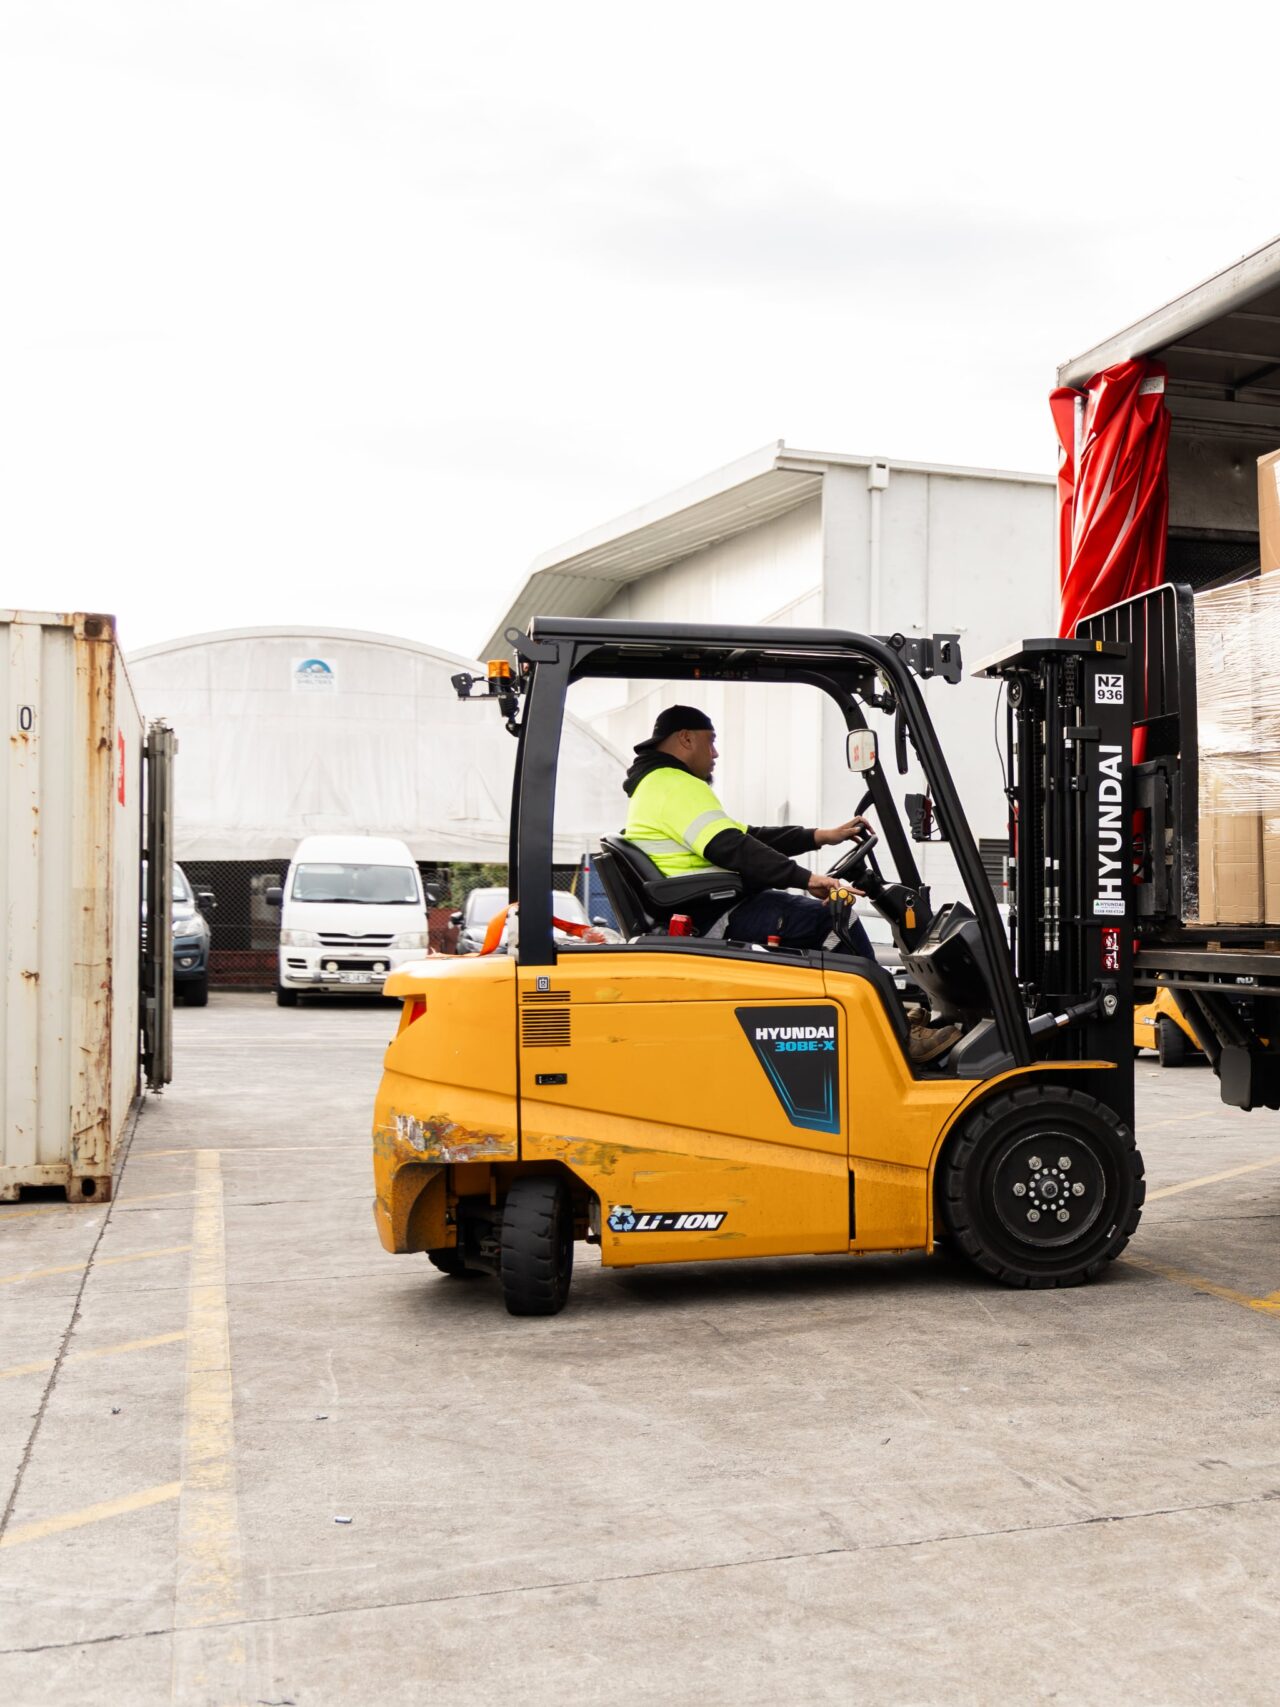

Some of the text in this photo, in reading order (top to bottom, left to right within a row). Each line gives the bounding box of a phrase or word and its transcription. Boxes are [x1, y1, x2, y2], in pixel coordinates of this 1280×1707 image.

[1098, 676, 1122, 688] NZ
[1097, 689, 1123, 701] 936
[1098, 745, 1122, 899] HYUNDAI
[755, 1026, 834, 1040] HYUNDAI
[774, 1040, 835, 1052] 30BE-X
